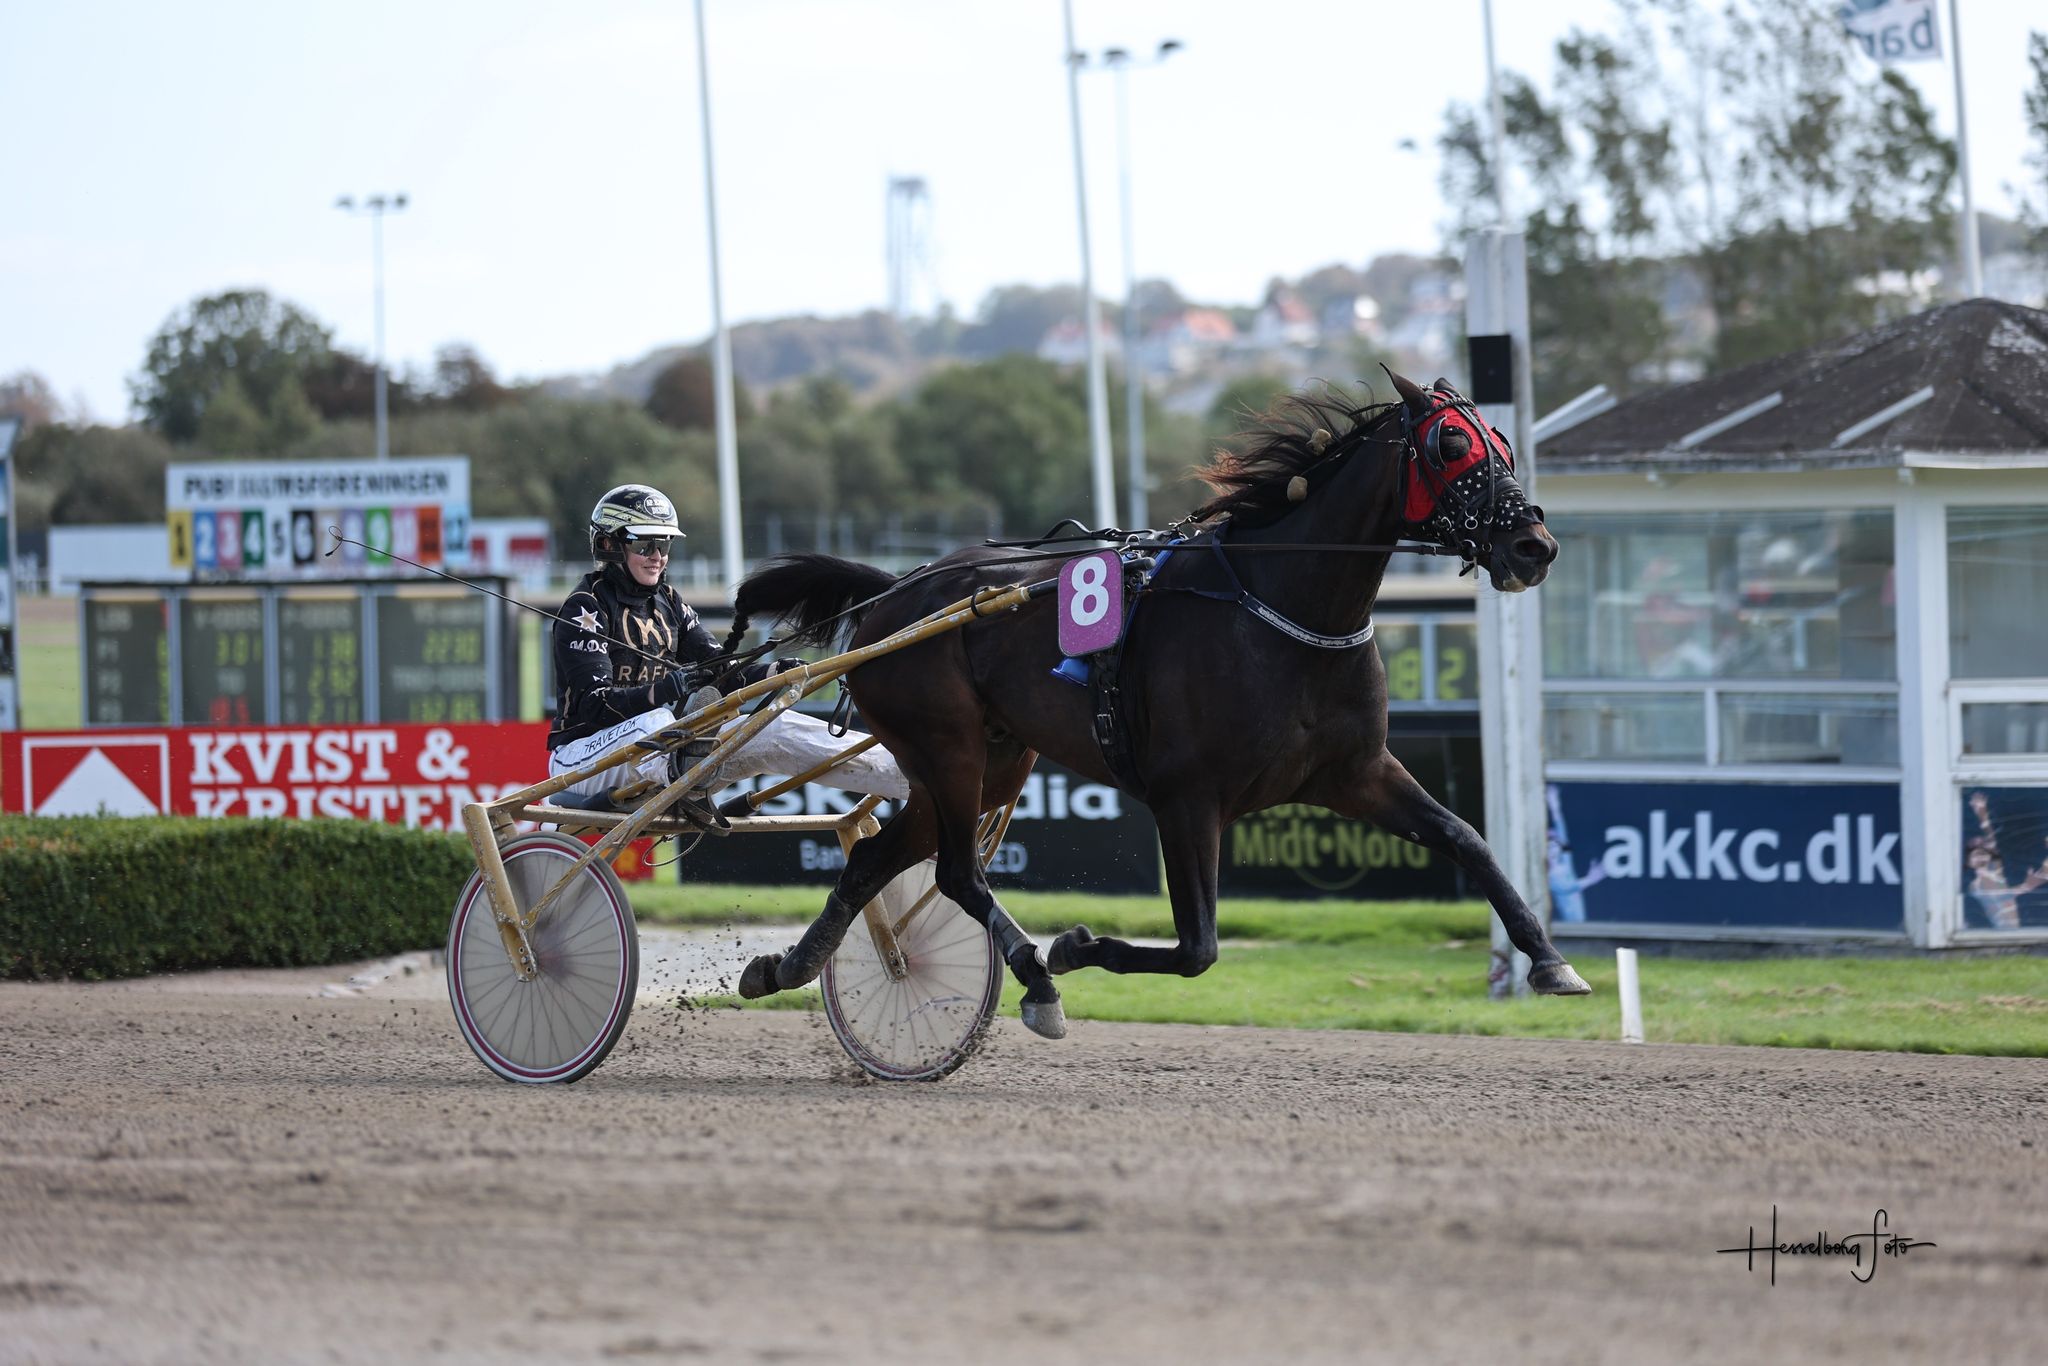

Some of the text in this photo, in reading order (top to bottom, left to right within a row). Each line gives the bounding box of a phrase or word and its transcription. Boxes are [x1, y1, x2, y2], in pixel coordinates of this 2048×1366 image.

[198, 516, 214, 561] 2
[220, 515, 237, 560] 3
[245, 513, 262, 561] 4
[271, 519, 285, 556] 5
[294, 513, 314, 560] 6
[1070, 556, 1110, 627] 8
[188, 729, 470, 785] KVIST &
[1603, 809, 1900, 885] akkc.dk
